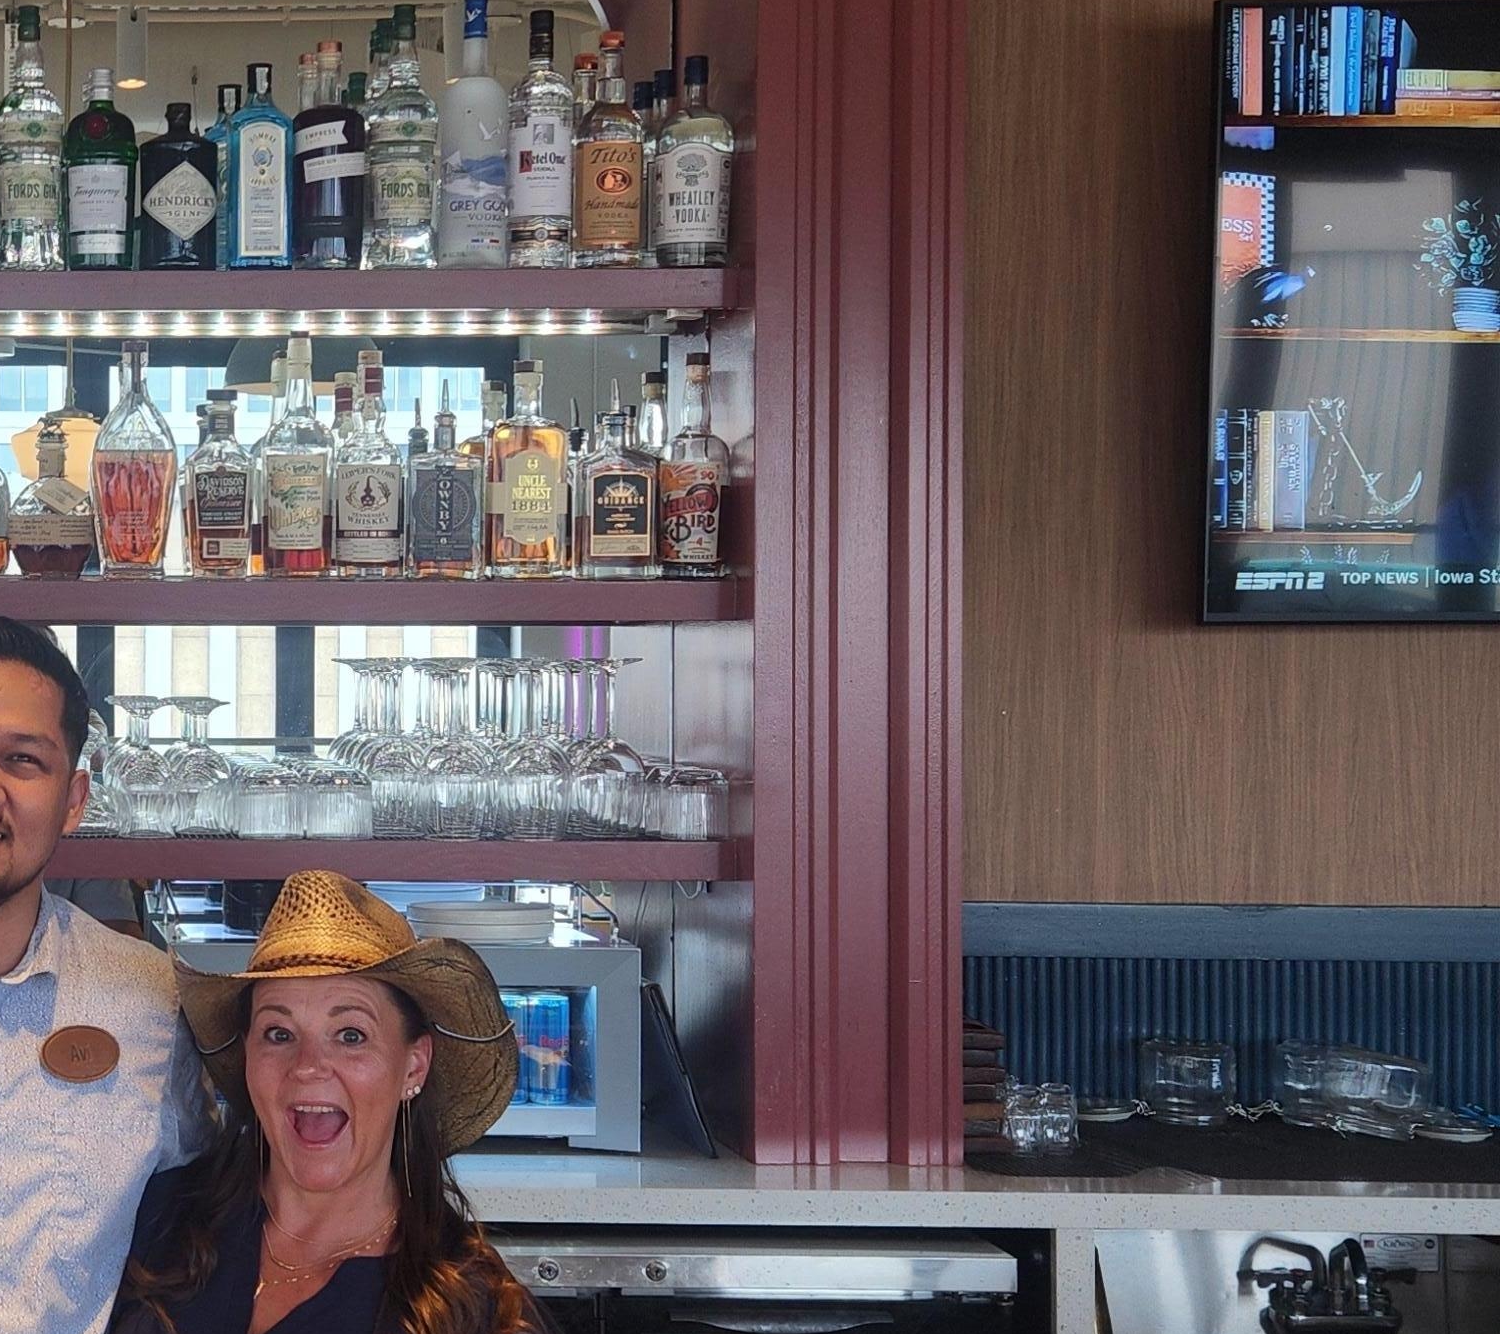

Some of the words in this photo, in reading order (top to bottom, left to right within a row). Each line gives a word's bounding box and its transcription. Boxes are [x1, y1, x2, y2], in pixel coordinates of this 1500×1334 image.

[305, 128, 337, 140] EMPRESS
[591, 148, 636, 164] Tito's
[7, 184, 40, 199] FORDS
[381, 183, 414, 199] FORDS
[668, 191, 715, 206] WHEATLEY
[450, 200, 480, 212] GREY
[675, 208, 708, 223] VODKA
[198, 474, 244, 489] DAVIDSON
[375, 469, 396, 480] FORK
[518, 475, 547, 486] UNCLE
[512, 487, 552, 499] NEAREST
[597, 496, 645, 505] GUIDANCE
[1340, 572, 1371, 585] TOP
[1375, 571, 1419, 585] NEWS
[1435, 569, 1474, 584] Iowa
